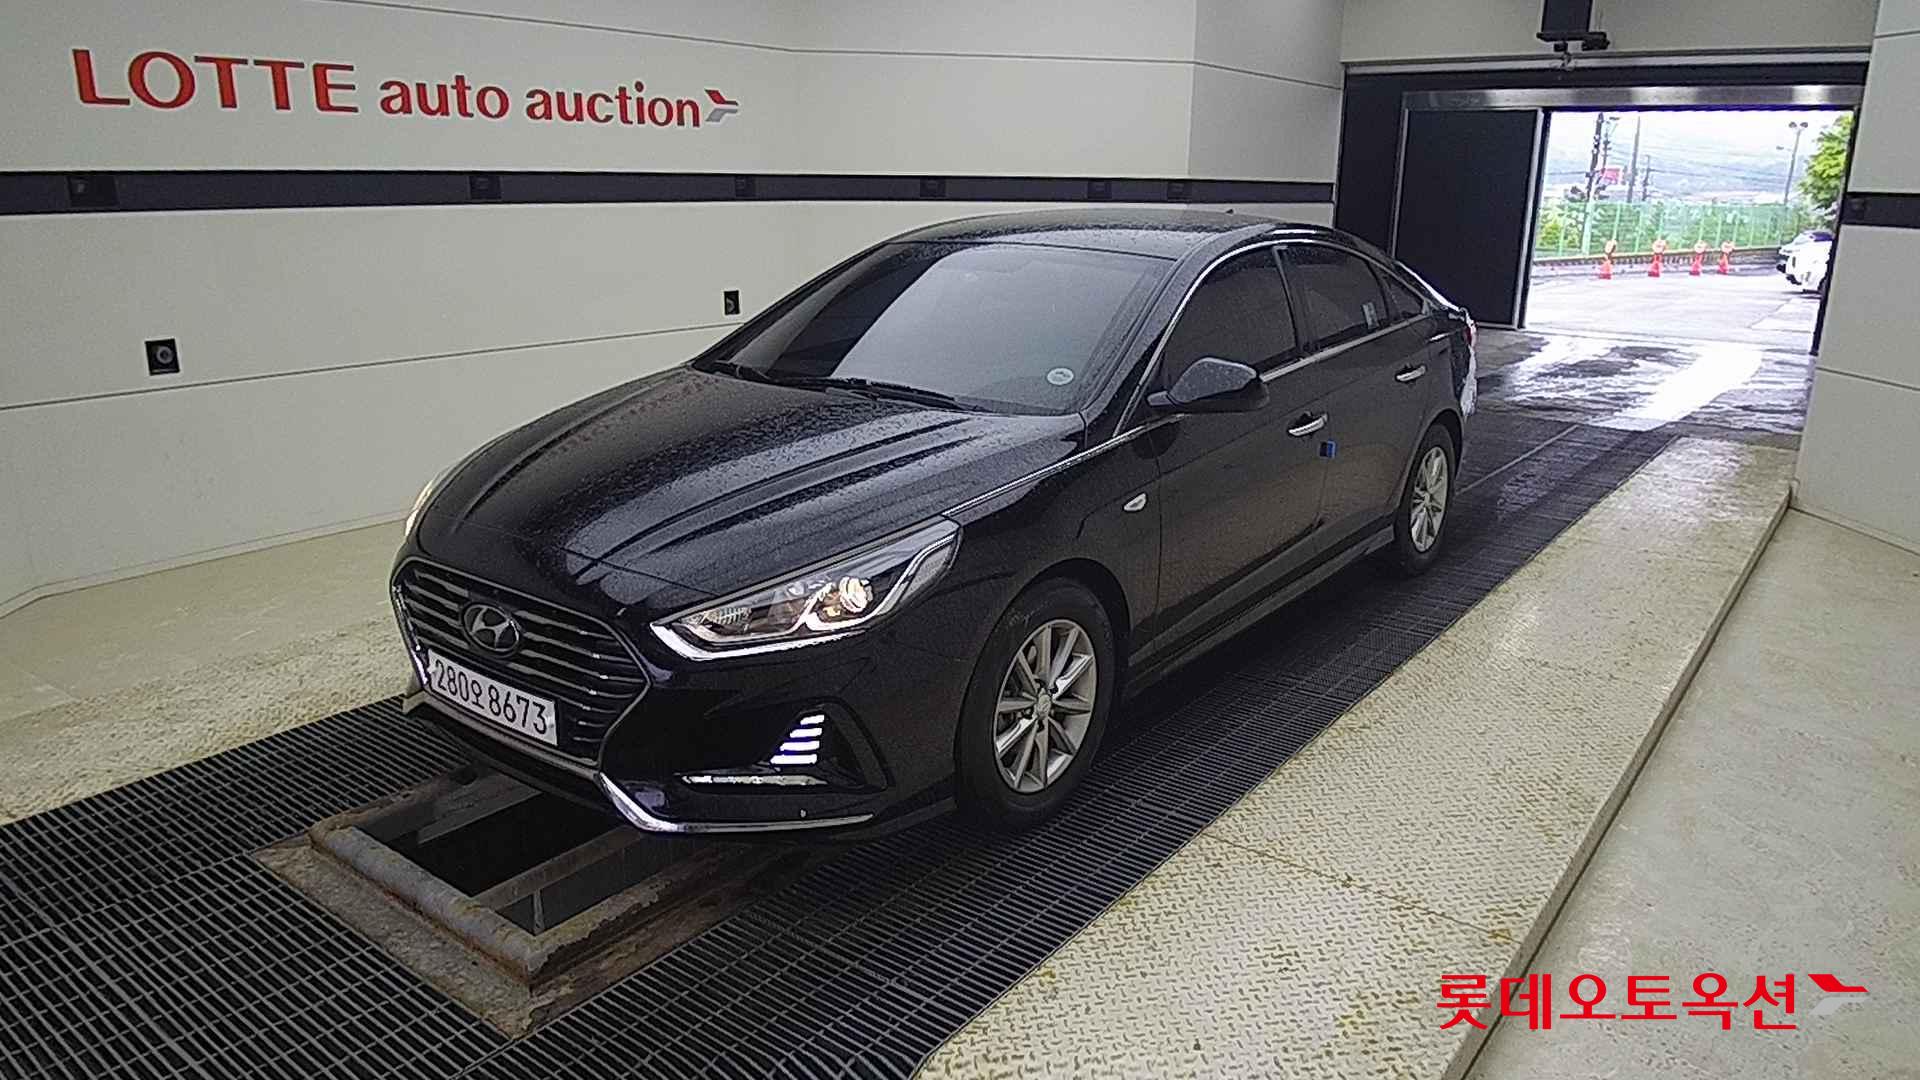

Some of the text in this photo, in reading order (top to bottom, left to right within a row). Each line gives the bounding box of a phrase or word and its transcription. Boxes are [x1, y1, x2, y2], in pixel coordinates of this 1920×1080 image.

[72, 47, 702, 128] LOTTE auto auction
[434, 659, 548, 735] 280오 8673
